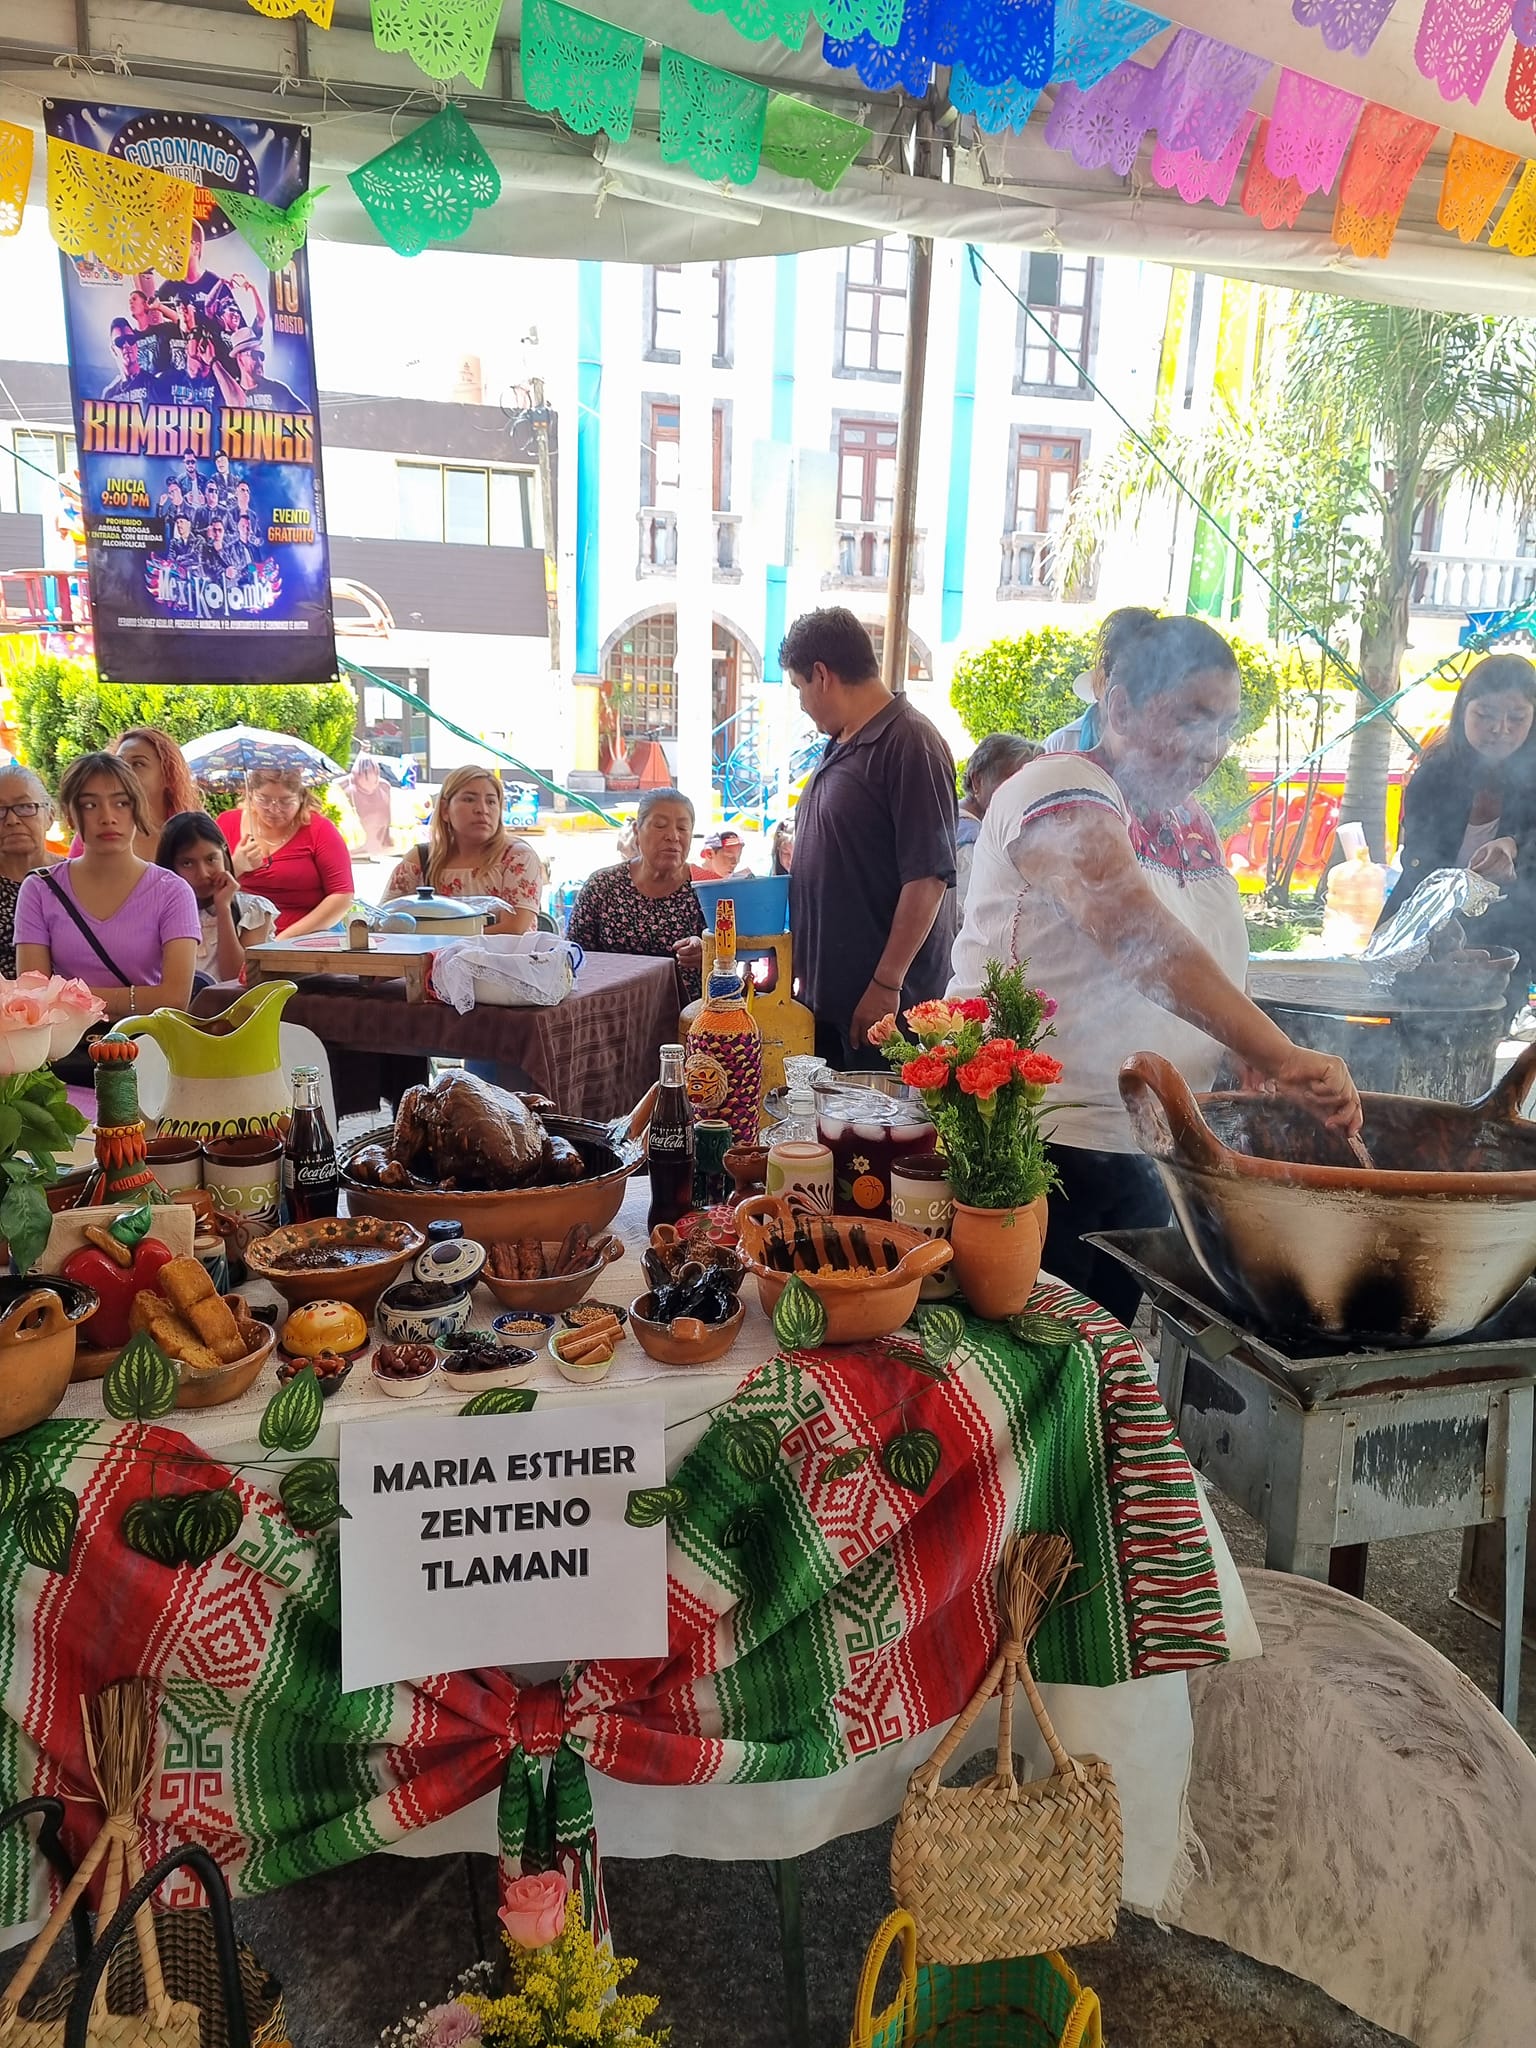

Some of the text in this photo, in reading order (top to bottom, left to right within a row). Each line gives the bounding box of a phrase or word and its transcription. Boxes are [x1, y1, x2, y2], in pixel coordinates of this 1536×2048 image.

[124, 136, 240, 183] CORONANGO
[164, 165, 203, 185] PUEBLA
[274, 314, 304, 335] AGOSTO
[82, 400, 314, 464] KUMBIA KINGS
[107, 478, 146, 493] INICIA
[101, 491, 150, 508] 9:00 PM
[105, 517, 143, 526] PROHIBIDO
[273, 508, 310, 525] EVENTO
[91, 531, 120, 540] ENTRADA
[121, 532, 136, 541] CON
[136, 534, 163, 542] BEBIDAS
[98, 524, 150, 534] ARMAS, DROGAS
[268, 526, 315, 544] GRATUITO
[372, 1445, 636, 1494] MARIA ESTHER
[420, 1497, 591, 1540] ZENTENO
[421, 1548, 590, 1592] TLAMANI
